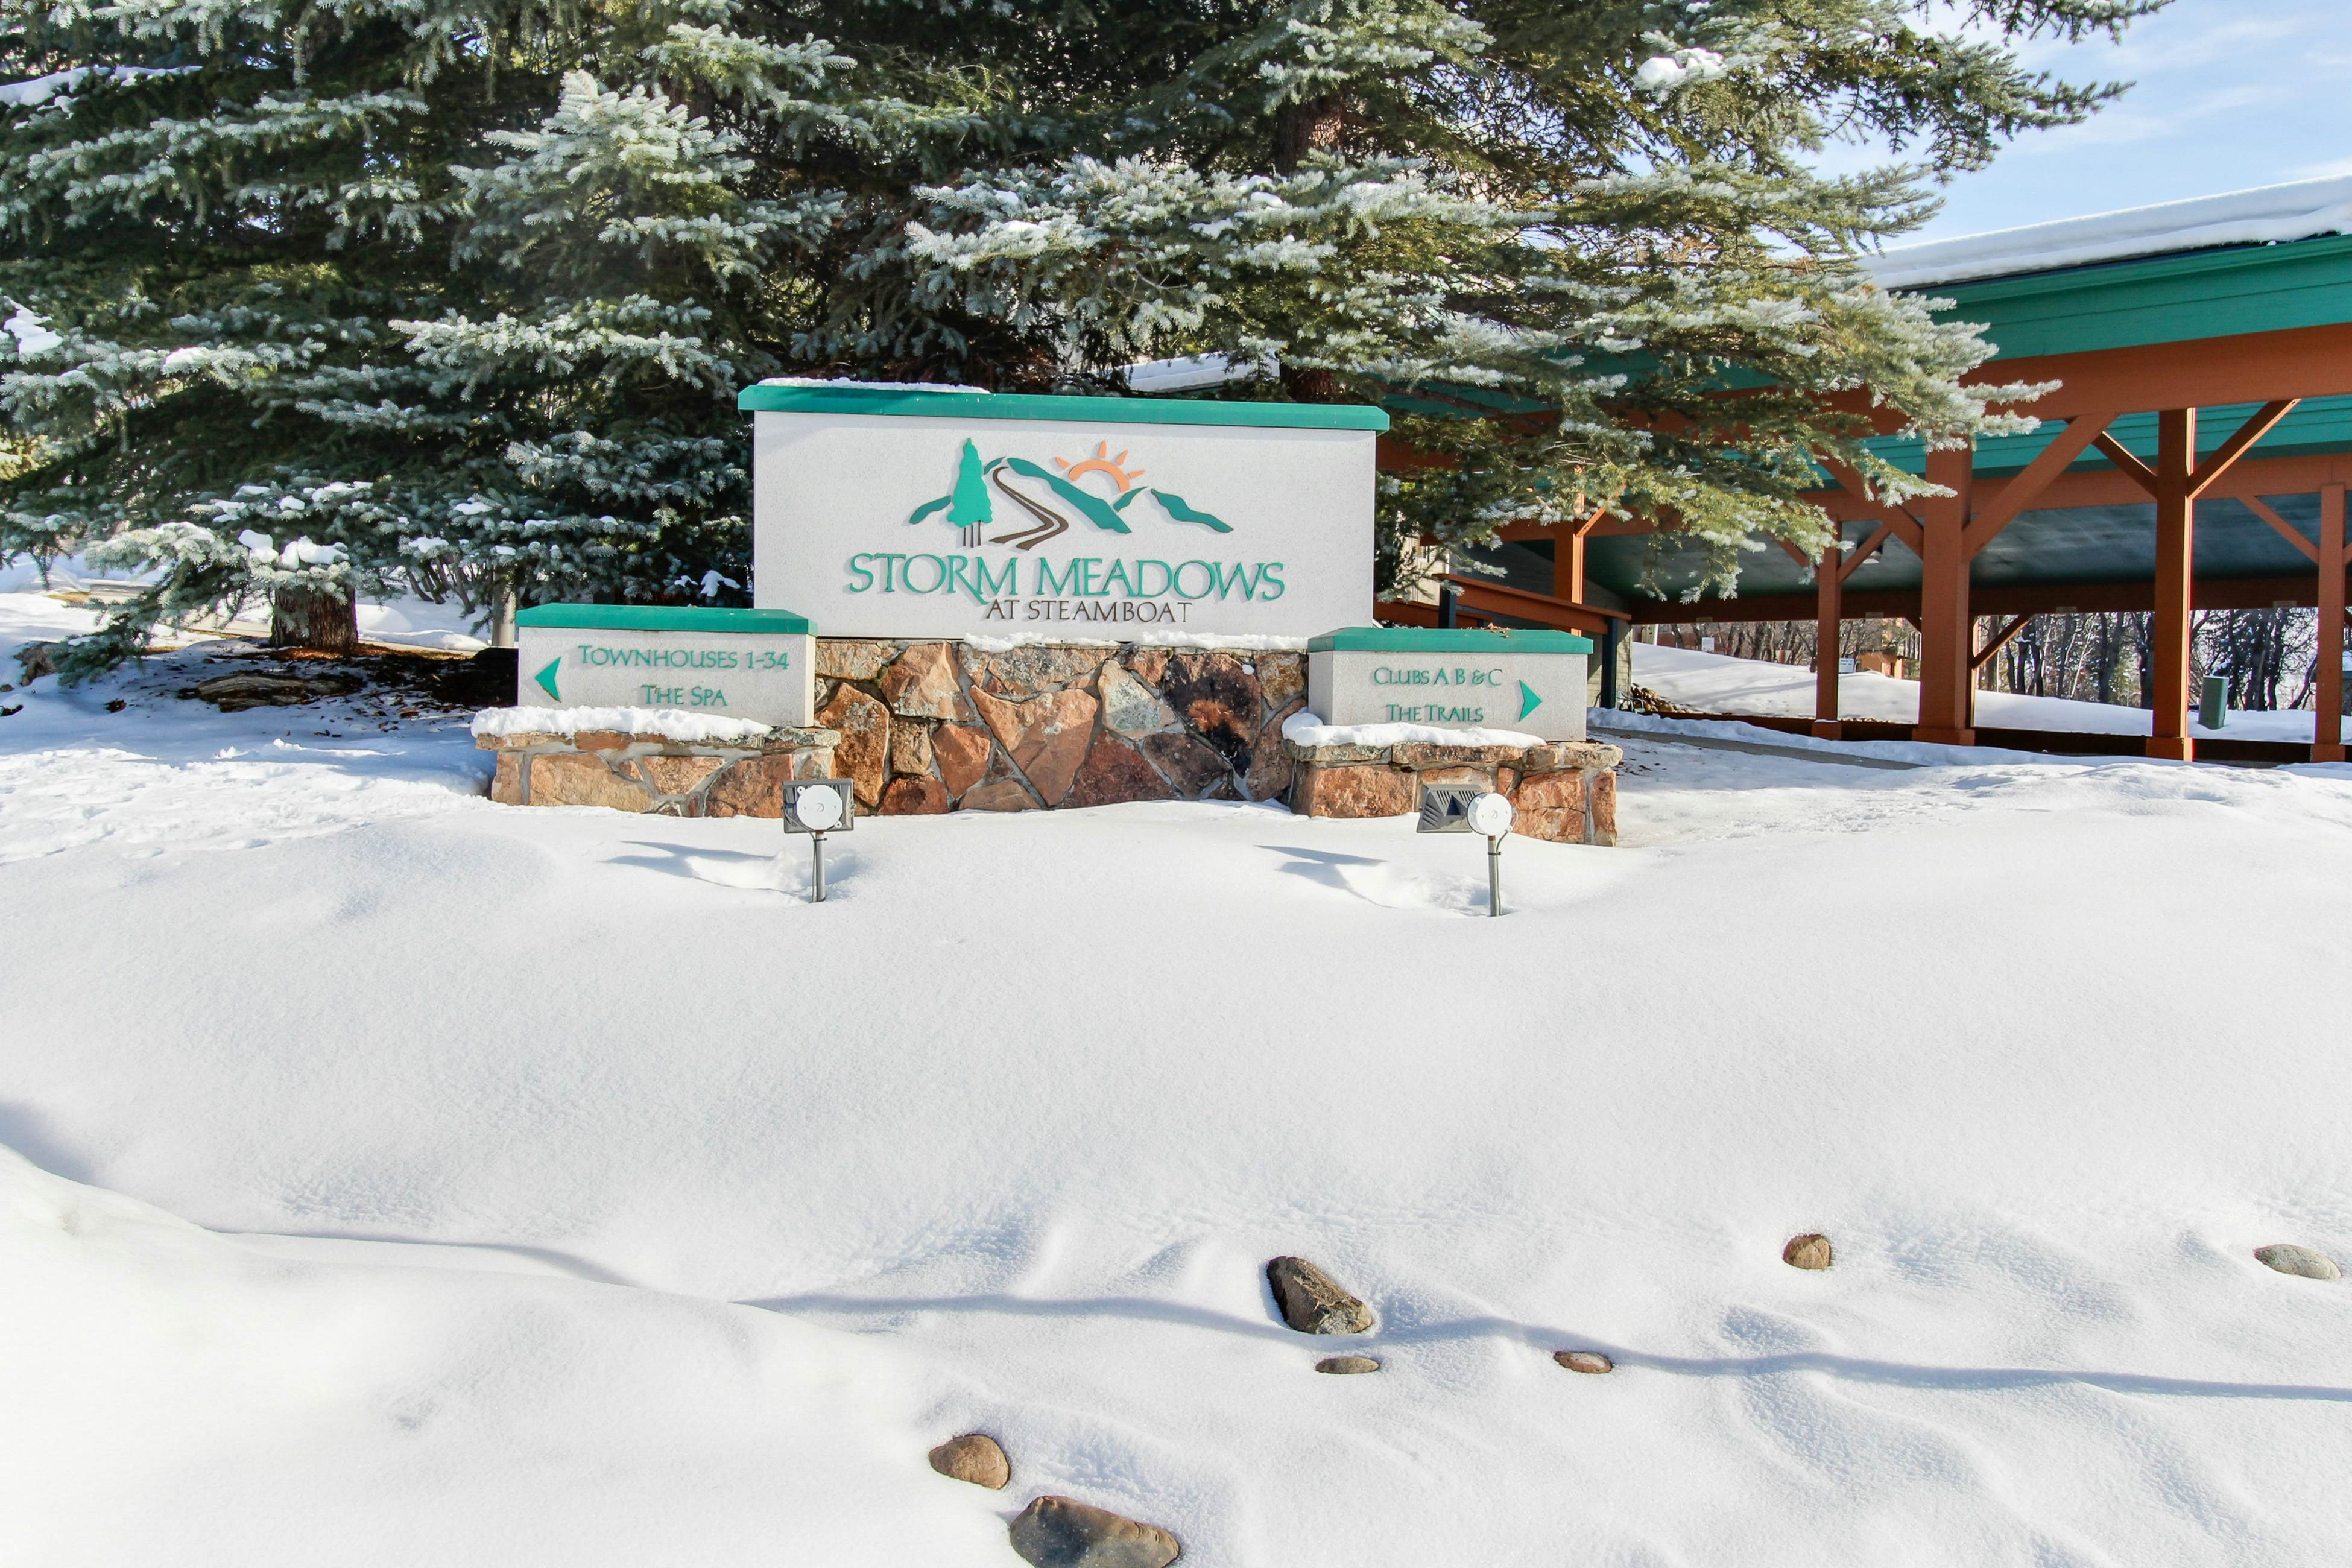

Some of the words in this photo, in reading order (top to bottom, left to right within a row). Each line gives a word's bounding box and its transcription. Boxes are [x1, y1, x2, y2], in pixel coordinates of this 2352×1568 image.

[849, 552, 1017, 605] STORM
[1036, 557, 1286, 602] MEADOWS
[985, 599, 1016, 620] AT
[1027, 600, 1193, 623] STEAMBOAT
[578, 645, 738, 668] TOWNHOUSES
[748, 651, 790, 670] 1-34
[1433, 668, 1450, 686] A
[1455, 668, 1467, 685] B
[1472, 670, 1485, 686] &
[1488, 669, 1503, 686] C
[641, 684, 684, 705] THE
[691, 686, 727, 707] SPA
[1386, 704, 1423, 722] THE
[1424, 704, 1484, 723] TRAILS
